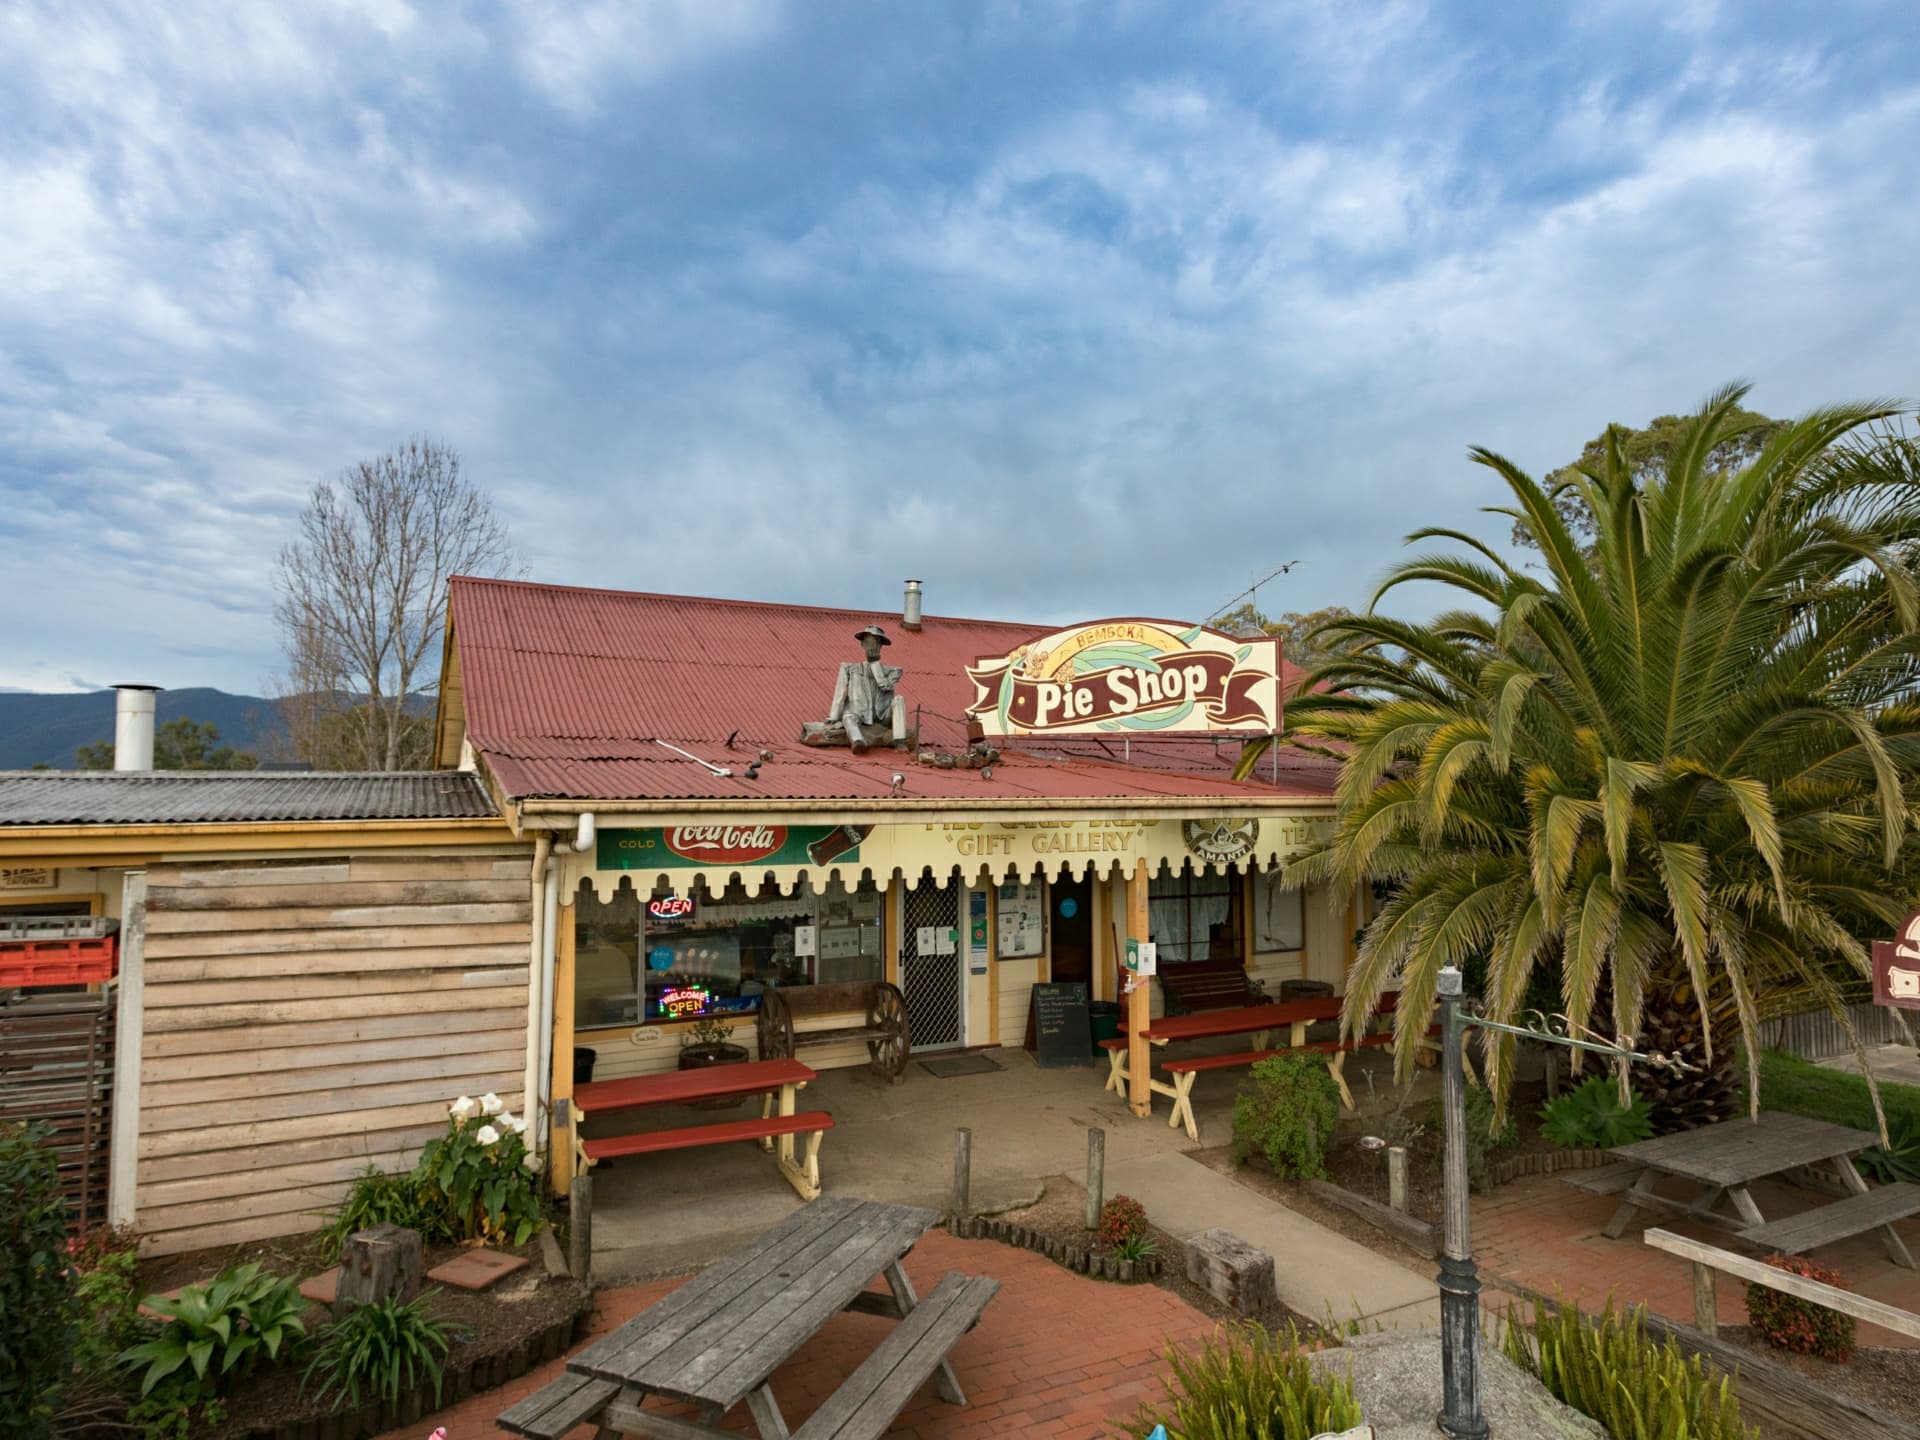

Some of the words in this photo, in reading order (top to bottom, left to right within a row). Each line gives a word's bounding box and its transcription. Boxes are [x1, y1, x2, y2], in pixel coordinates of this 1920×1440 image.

[1076, 626, 1145, 648] BEMBOKA
[1034, 682, 1094, 727] Pie
[1106, 665, 1208, 714] Shop
[619, 840, 656, 849] COLD
[1197, 847, 1247, 862] AMANTI
[650, 901, 692, 913] OPEN
[662, 991, 706, 1004] WELCOME
[669, 1000, 703, 1013] OPEN
